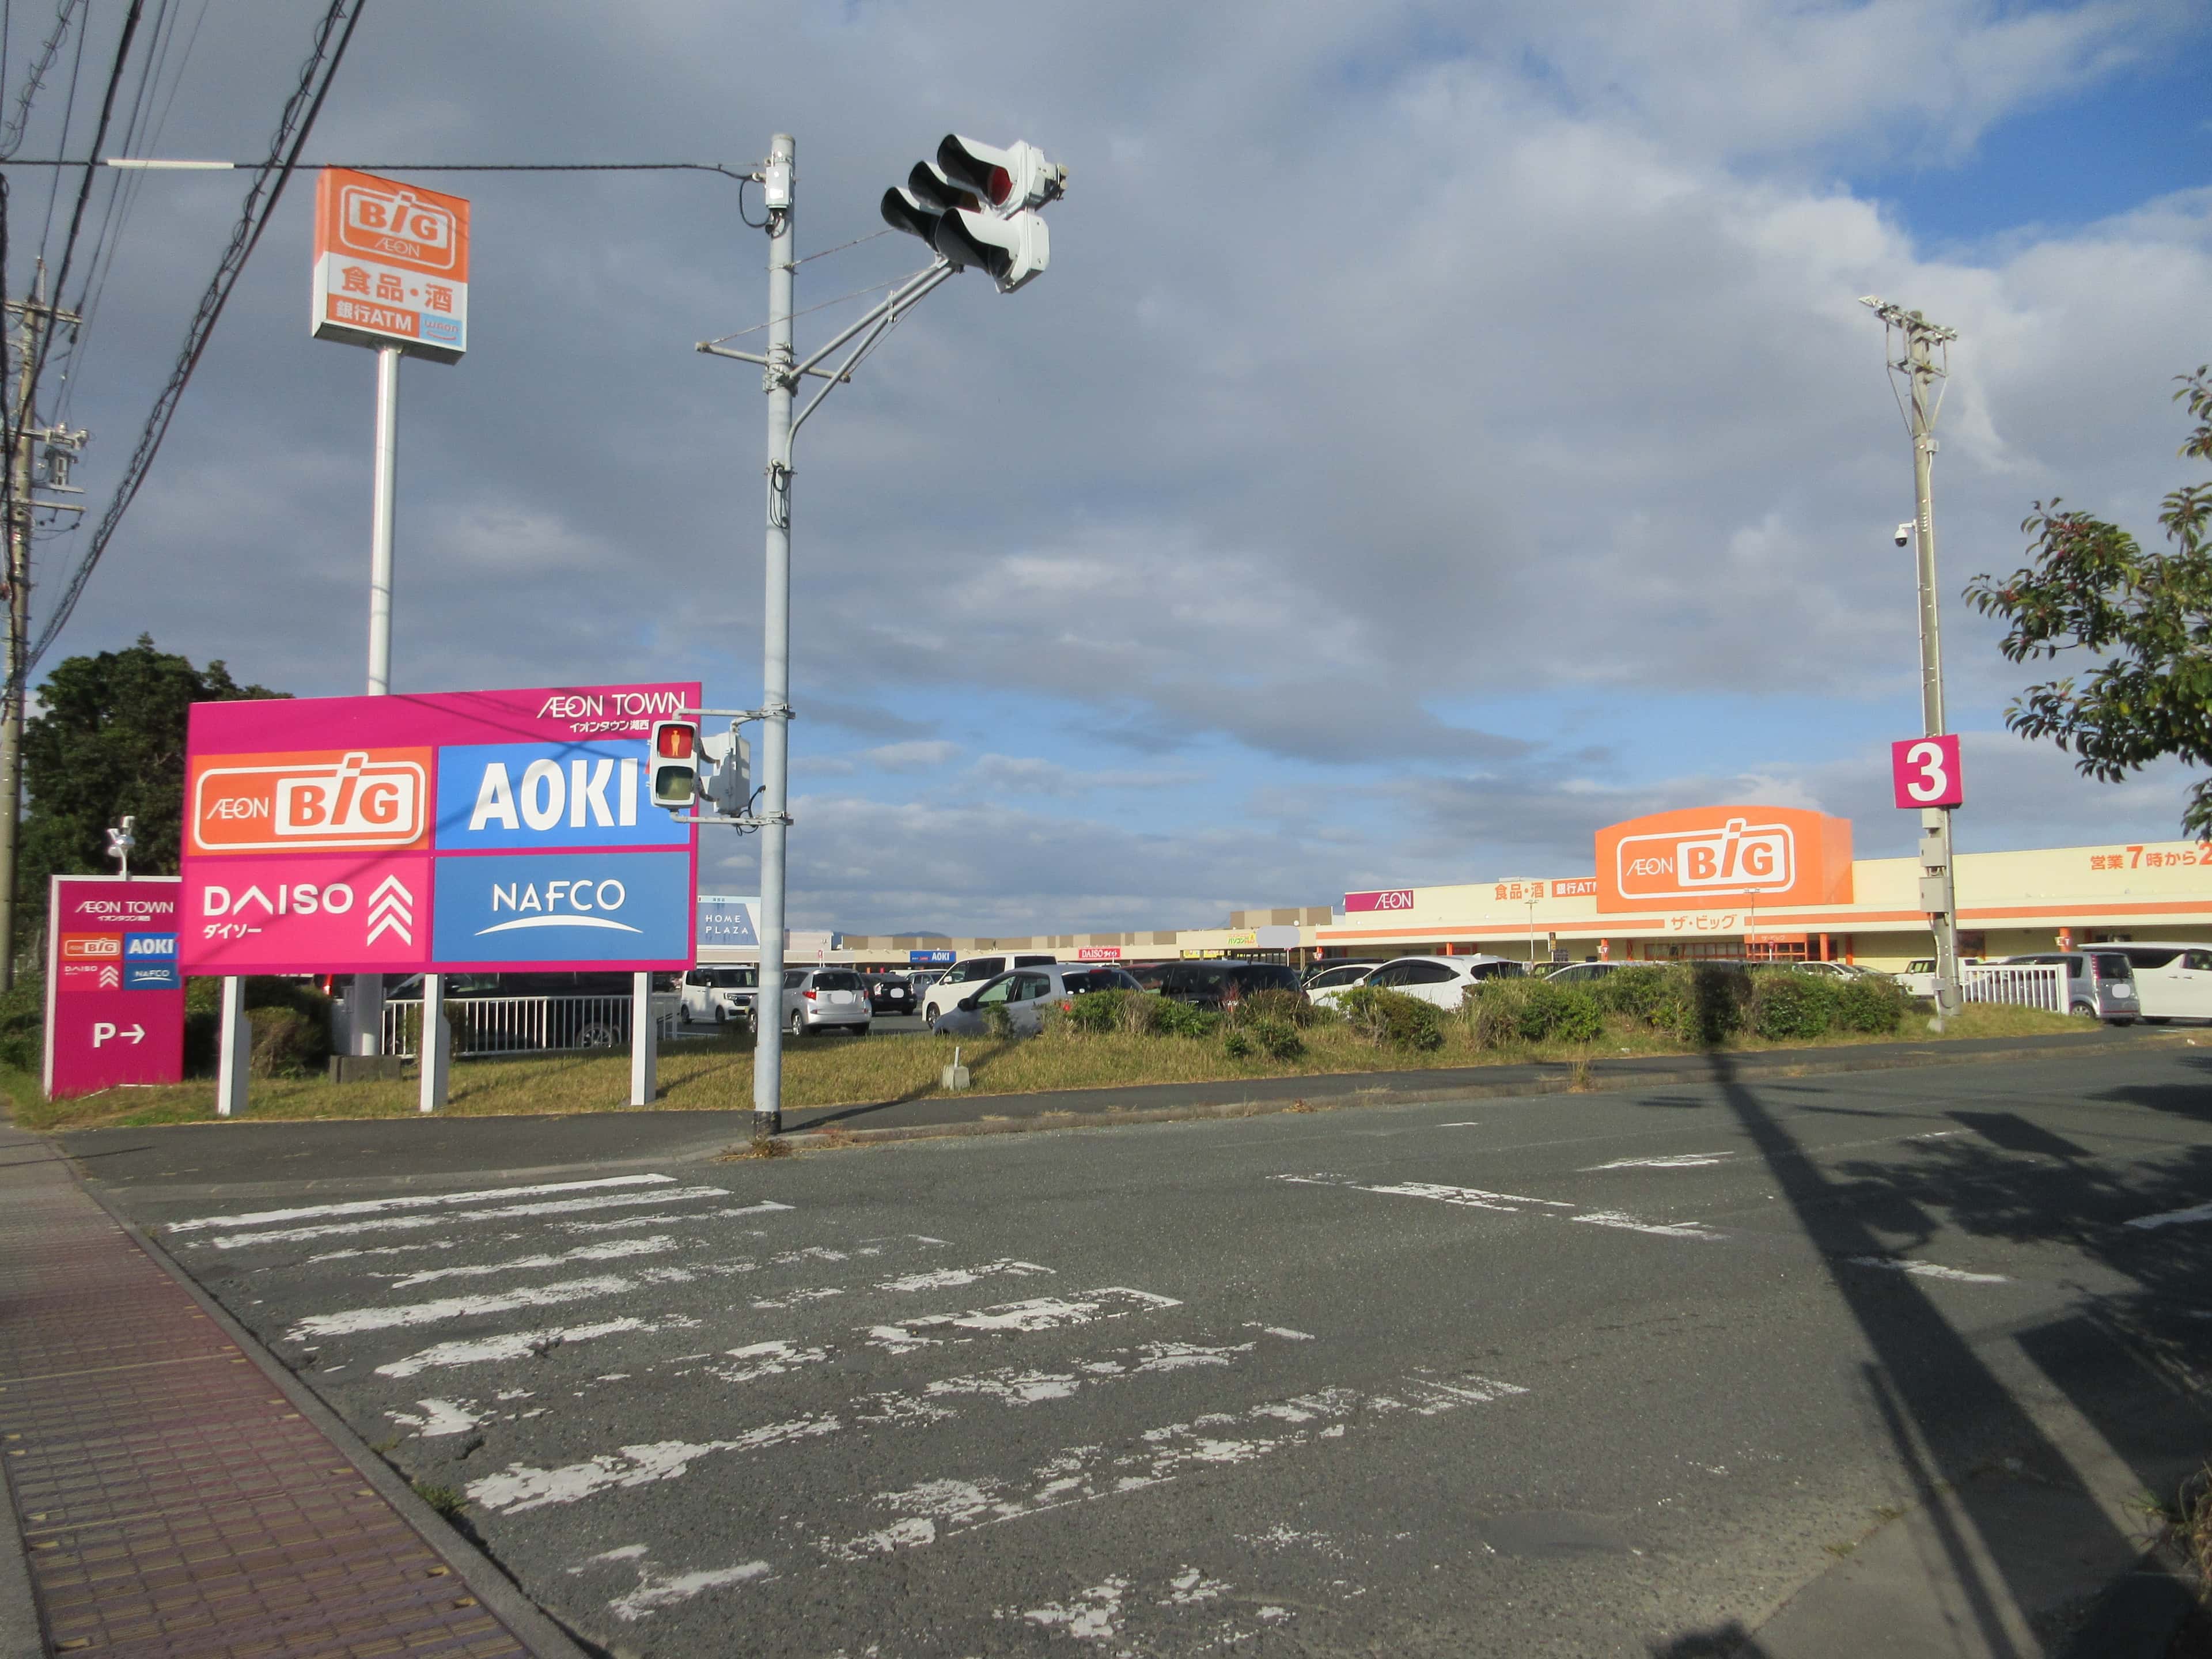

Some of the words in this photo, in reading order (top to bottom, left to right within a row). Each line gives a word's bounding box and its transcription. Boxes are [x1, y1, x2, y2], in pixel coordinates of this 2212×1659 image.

[336, 300, 411, 332] 銀行ATM
[612, 691, 685, 715] TOWN
[1907, 743, 1947, 801] 3
[468, 757, 638, 831] AOKI
[203, 882, 354, 916] DAISO
[493, 879, 625, 912] NAFCO
[125, 902, 174, 913] TOWN
[706, 914, 741, 922] HOME
[203, 923, 262, 939] ダイソー
[706, 926, 748, 934] PLAZA
[128, 938, 174, 954] AOKI
[1081, 949, 1103, 958] DAISO
[931, 952, 949, 961] AOKI
[93, 1023, 115, 1048] P
